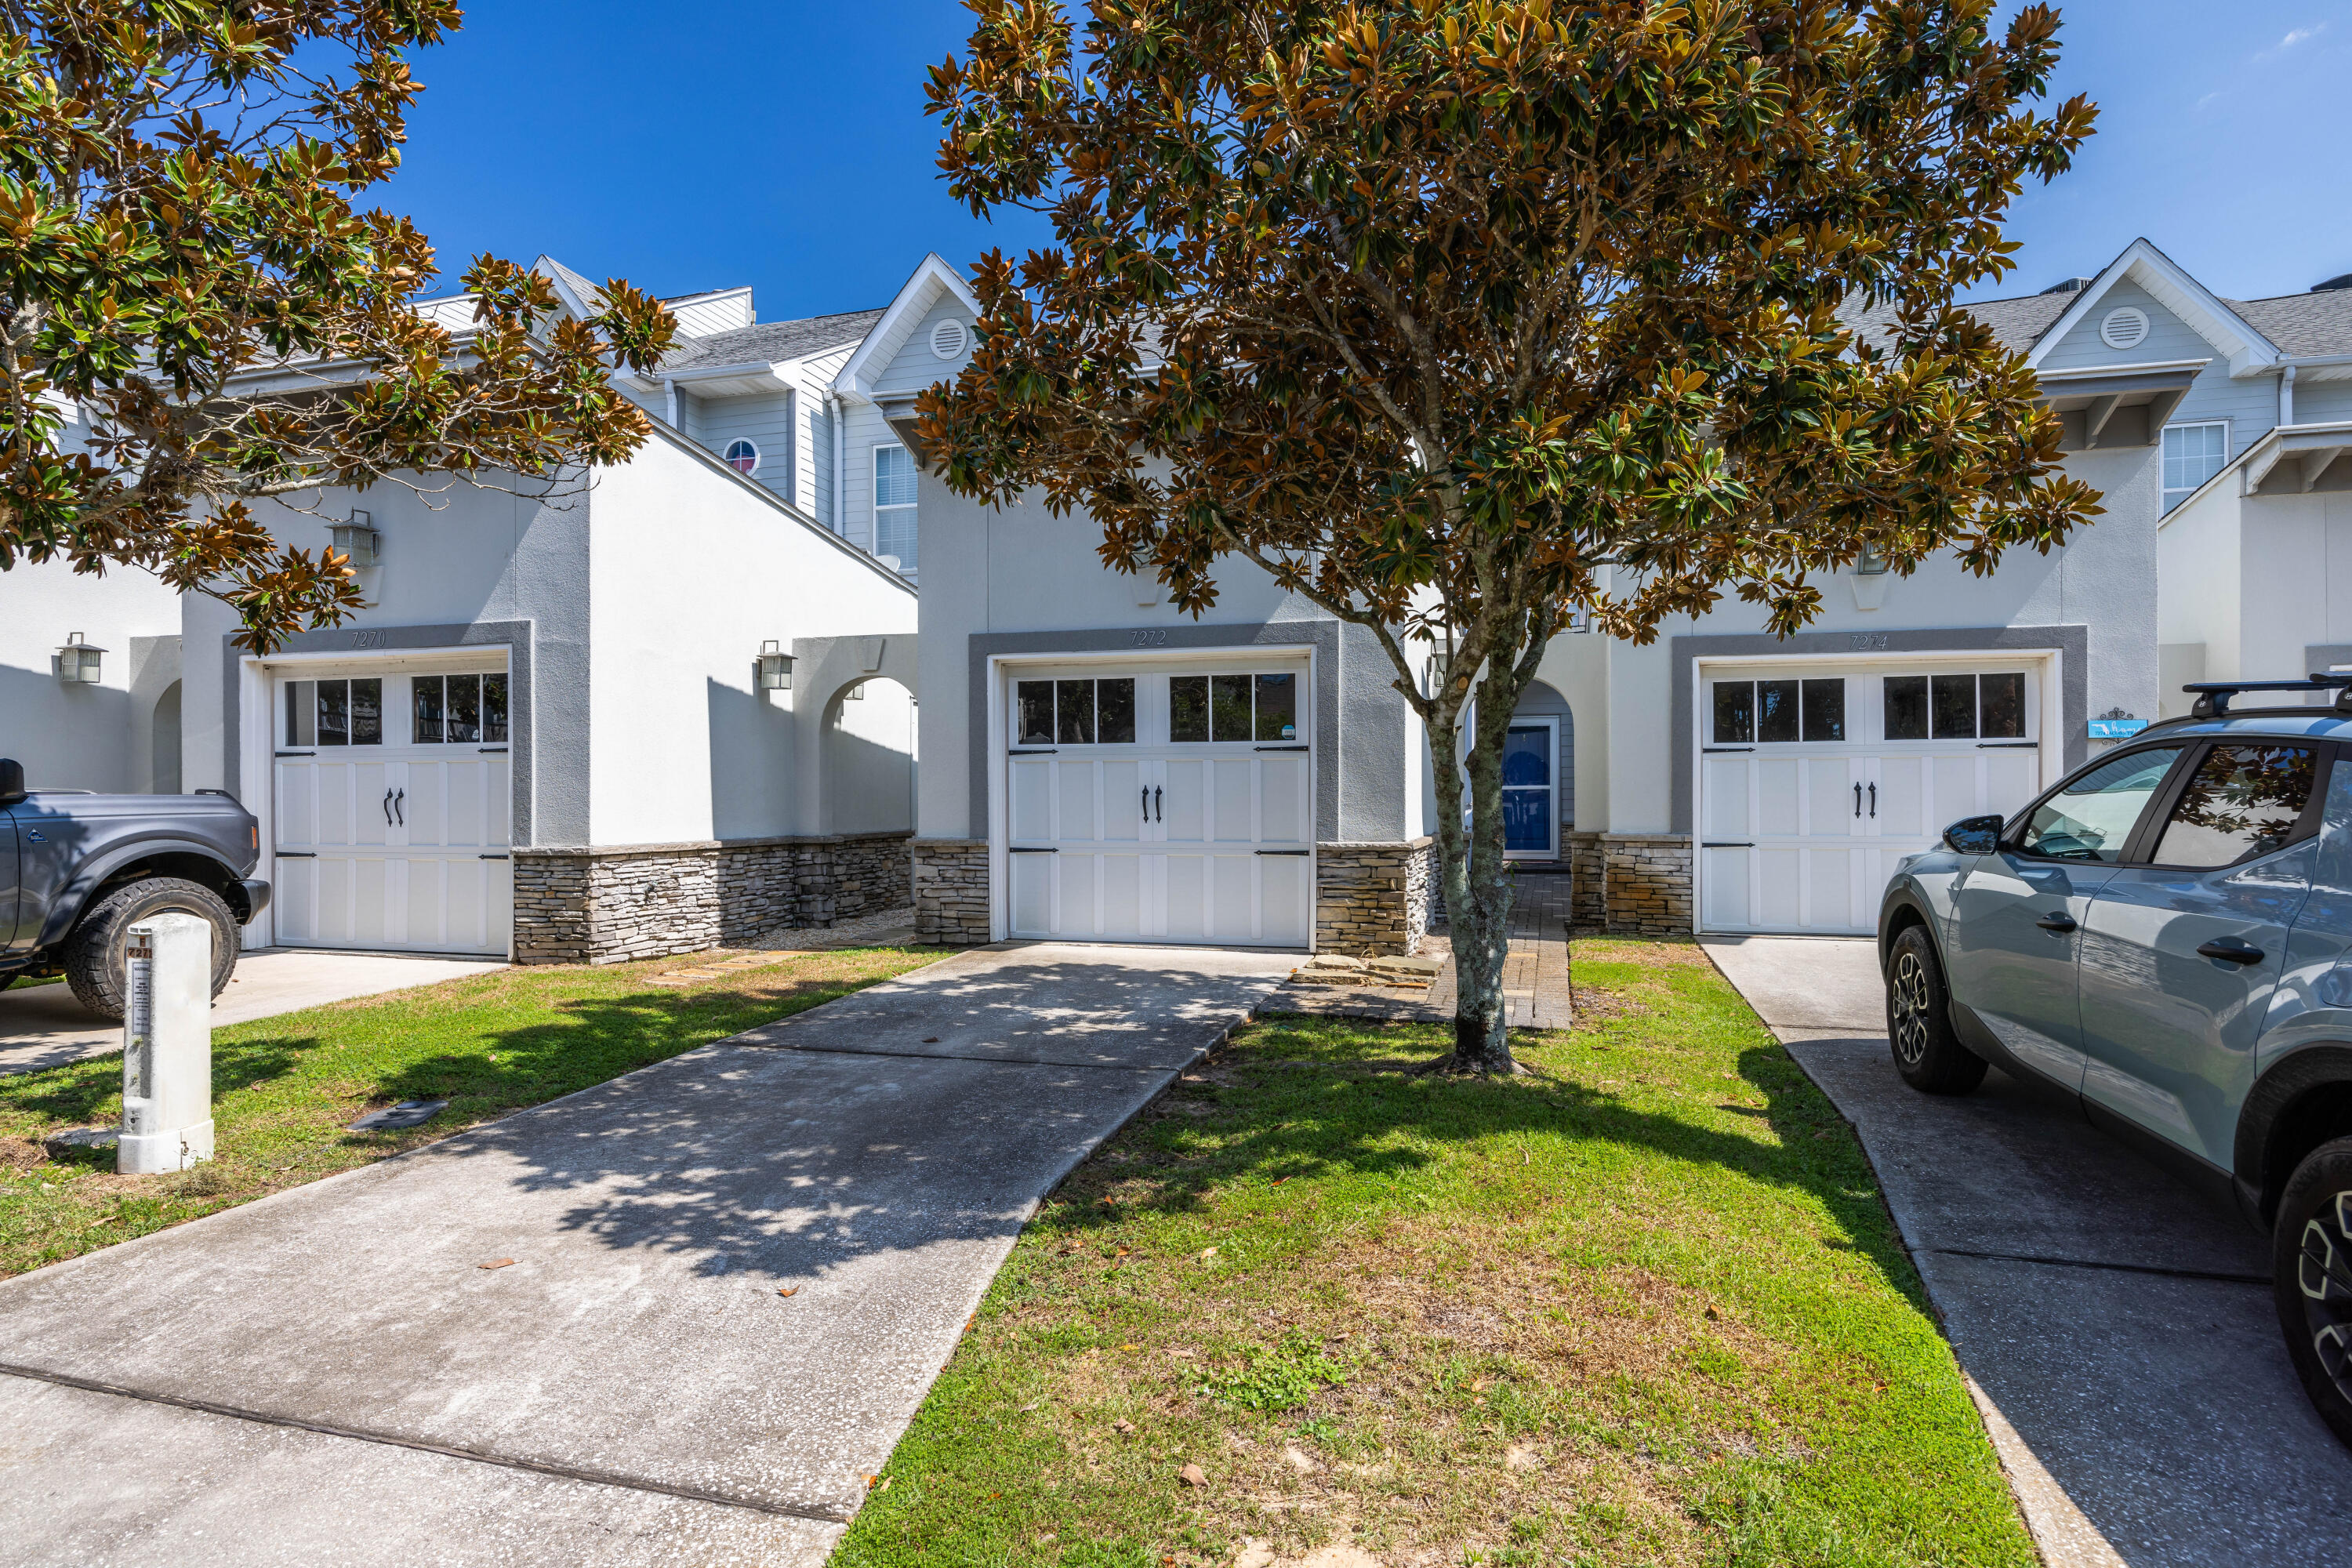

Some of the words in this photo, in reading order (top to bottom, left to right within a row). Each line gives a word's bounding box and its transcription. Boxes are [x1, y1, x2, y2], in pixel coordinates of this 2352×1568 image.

[351, 630, 386, 647] 7270
[1131, 630, 1167, 646] 7272
[1849, 634, 1888, 650] 7274
